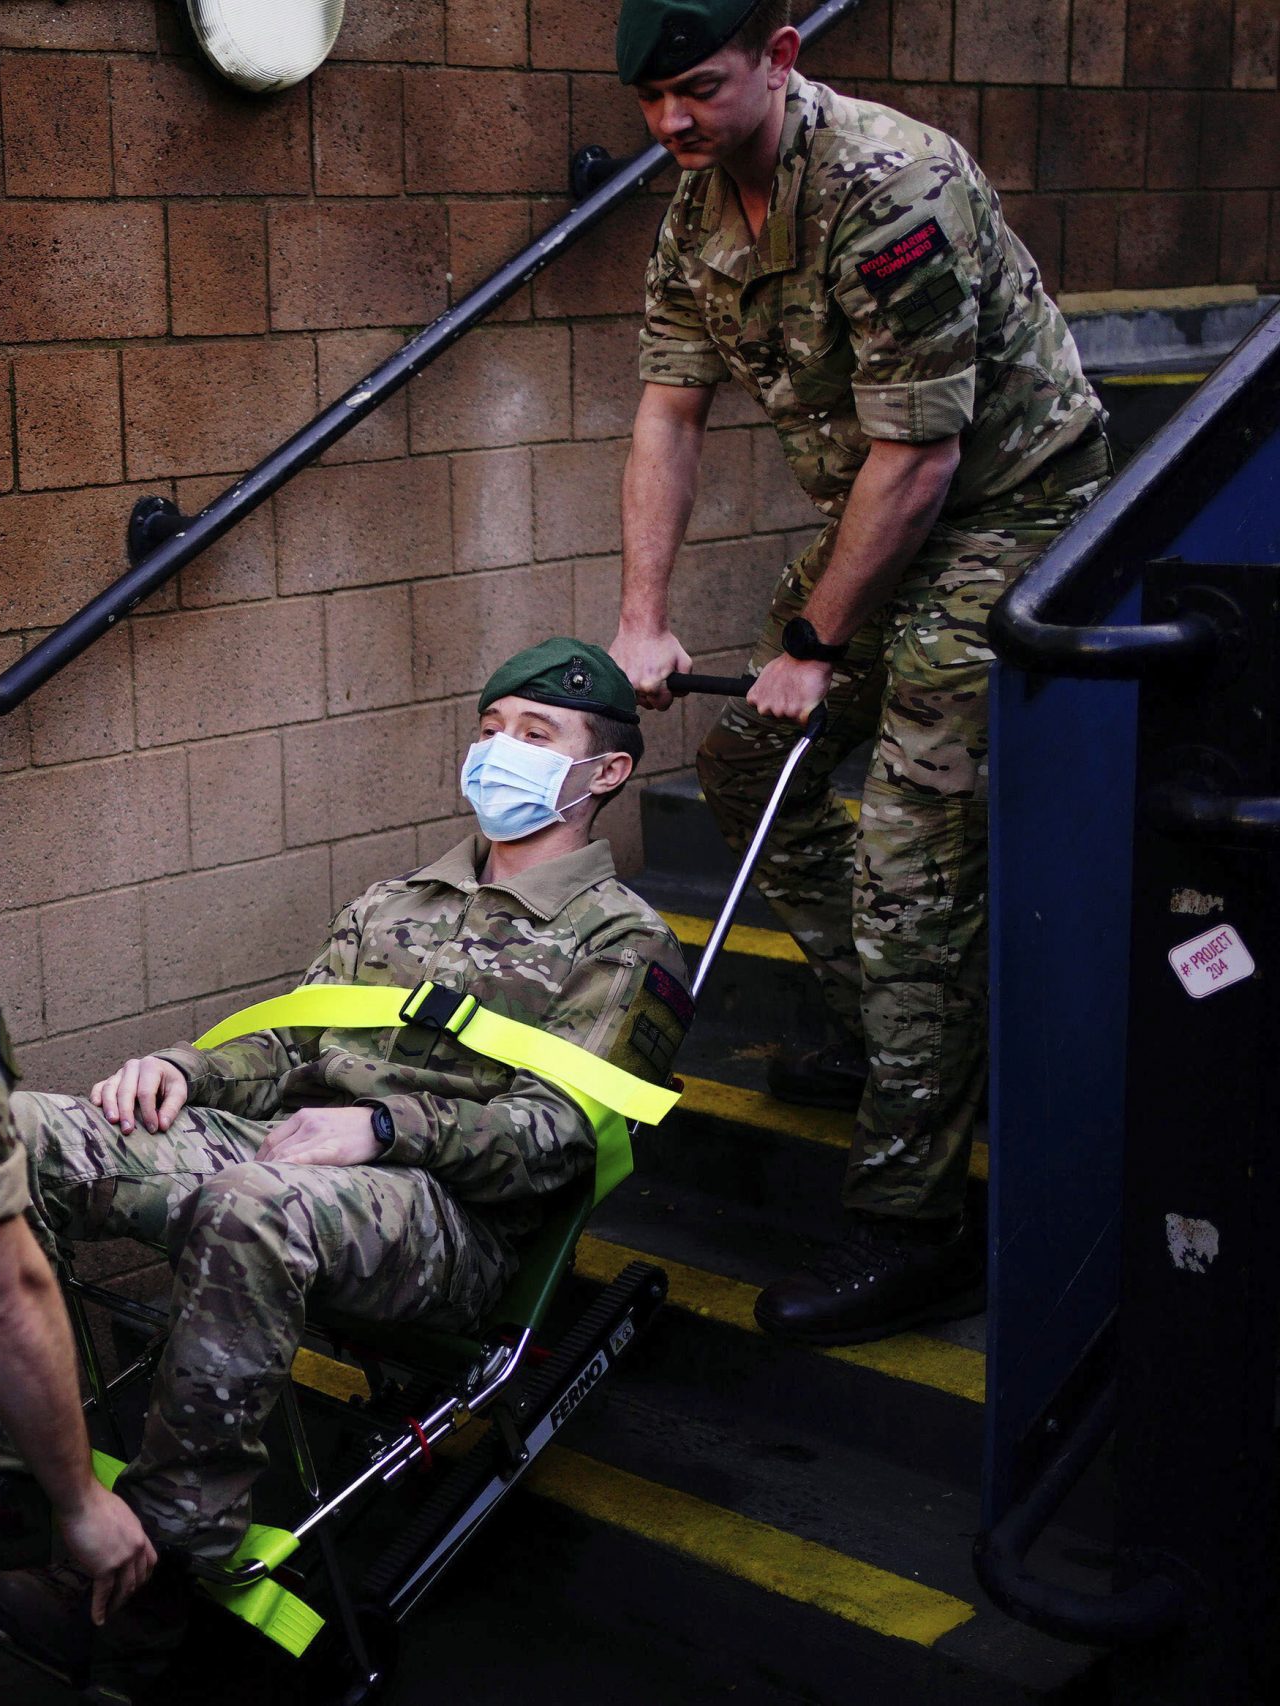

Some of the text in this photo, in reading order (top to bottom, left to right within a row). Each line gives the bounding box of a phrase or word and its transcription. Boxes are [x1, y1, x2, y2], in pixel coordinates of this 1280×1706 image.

[861, 224, 937, 274] ROYAL MARINES
[876, 241, 933, 279] COMMANDO
[1189, 931, 1233, 970] PROJECT
[1205, 958, 1229, 980] 204
[548, 1359, 603, 1431] FERNO
